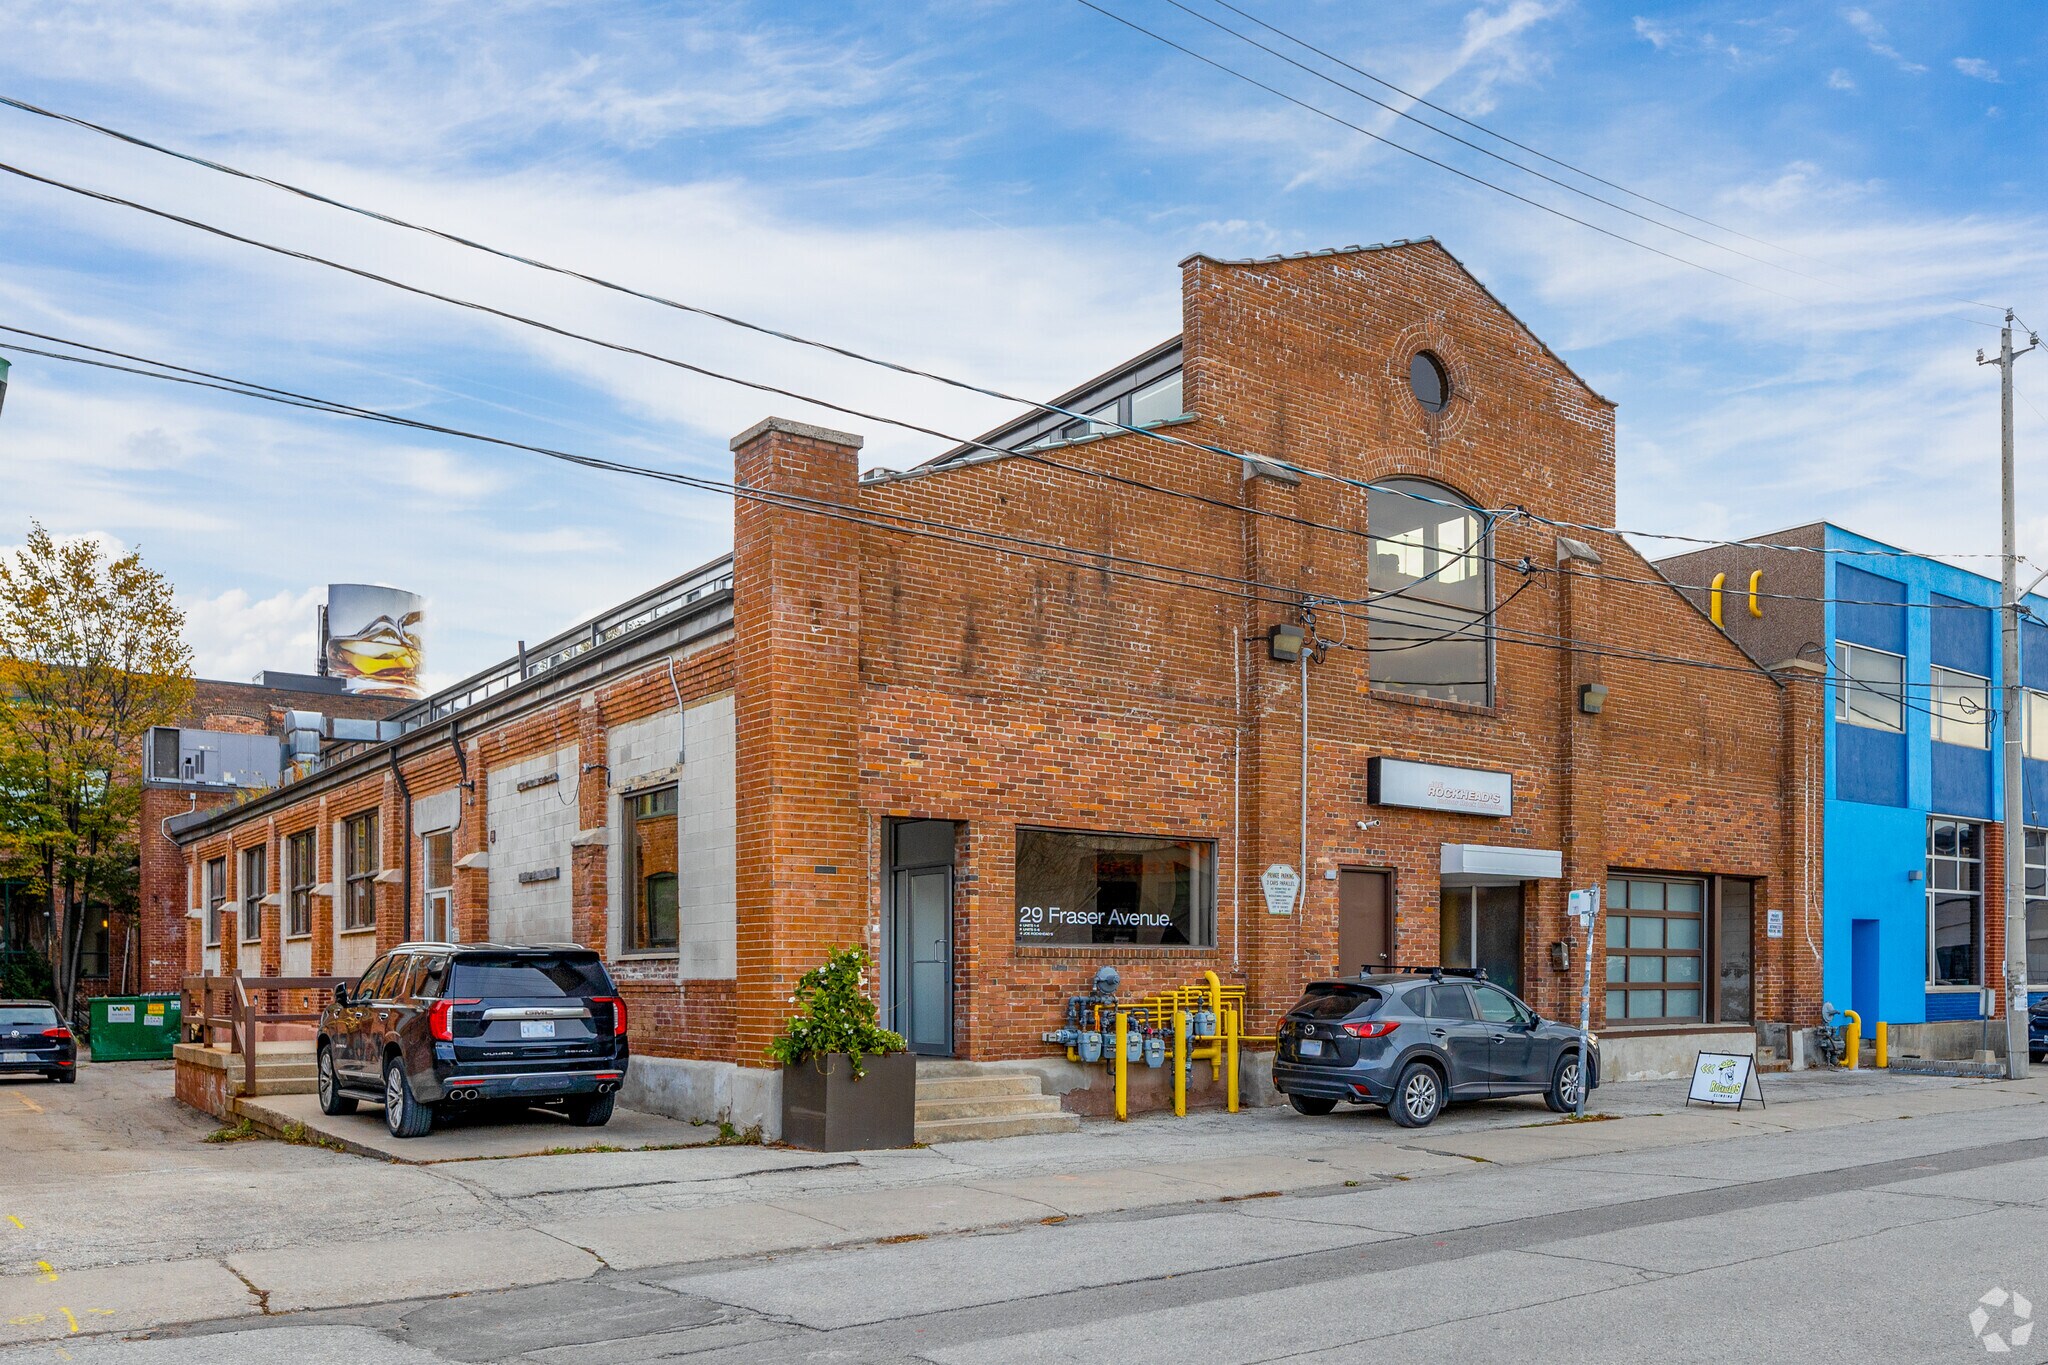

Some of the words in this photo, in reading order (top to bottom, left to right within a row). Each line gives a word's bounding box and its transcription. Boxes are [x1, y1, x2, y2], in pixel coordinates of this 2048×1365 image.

[1427, 786, 1501, 804] ROCKHEAD'S
[1019, 906, 1043, 923] 29
[1049, 906, 1105, 925] Fraser
[1107, 908, 1173, 927] Avenue.
